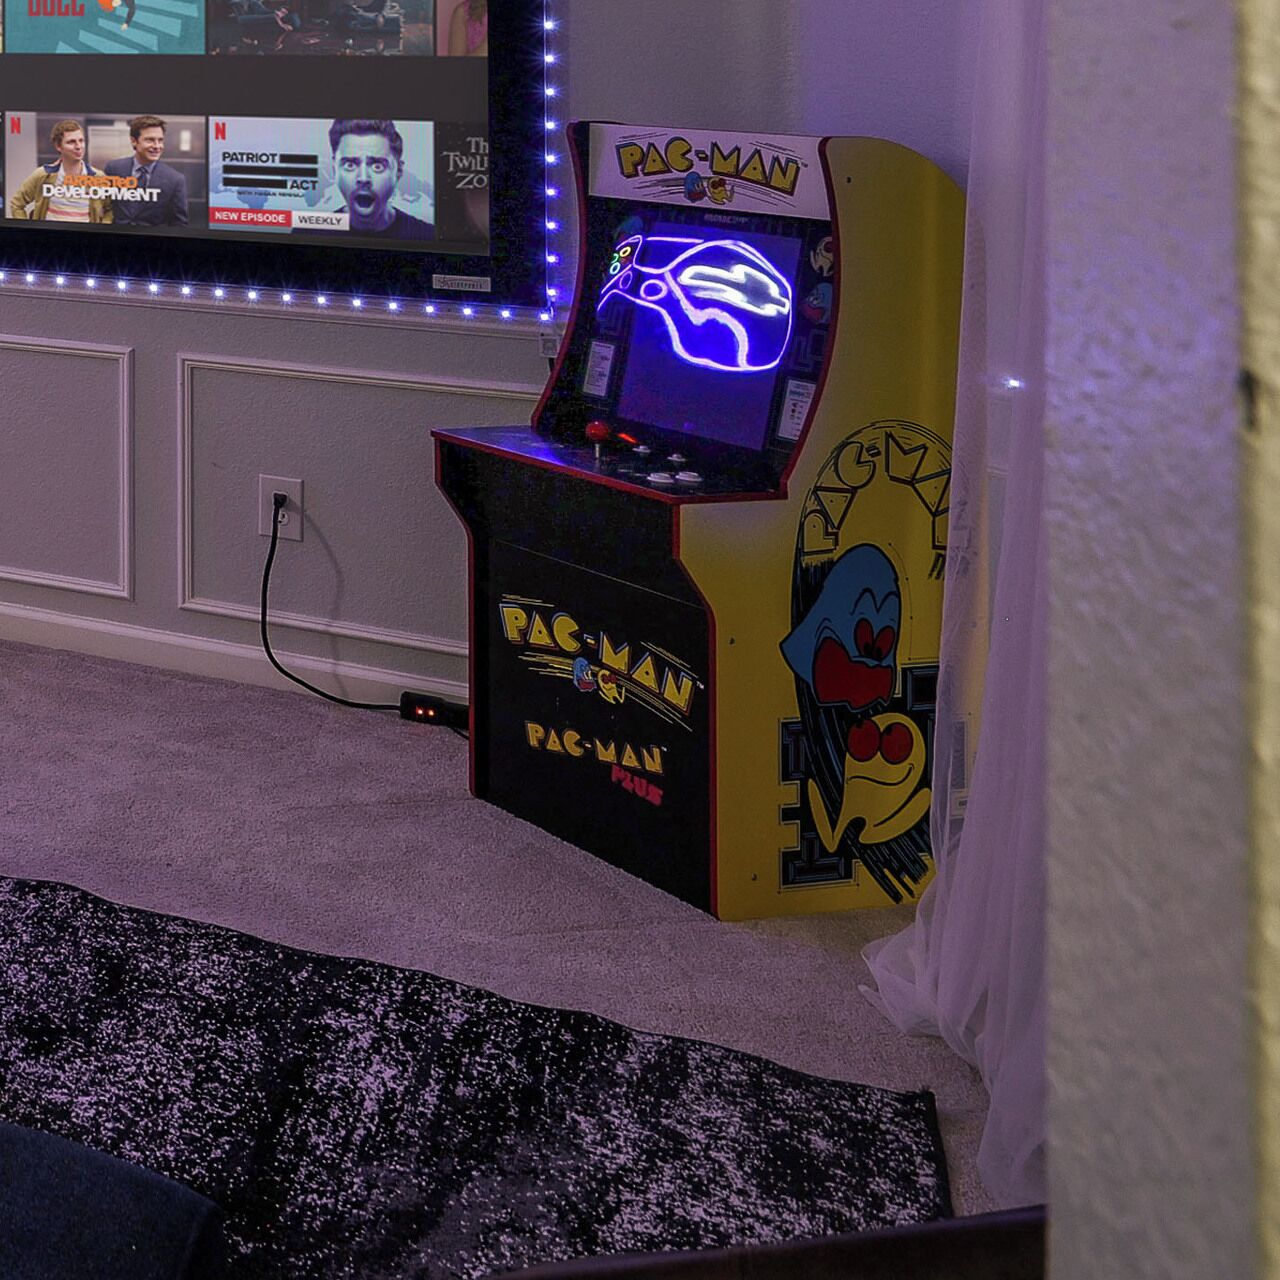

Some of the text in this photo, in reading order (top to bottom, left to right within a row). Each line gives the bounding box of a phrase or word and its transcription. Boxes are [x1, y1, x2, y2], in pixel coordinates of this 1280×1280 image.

[466, 136, 489, 153] Th
[222, 151, 277, 163] PATRIOT
[615, 136, 801, 196] PAC-MAN
[290, 179, 318, 190] ACT
[215, 211, 286, 223] NEW EPISODE
[298, 215, 342, 225] WEEKLY
[499, 603, 696, 716] PAC-MAN
[525, 721, 665, 775] PAC-MAN
